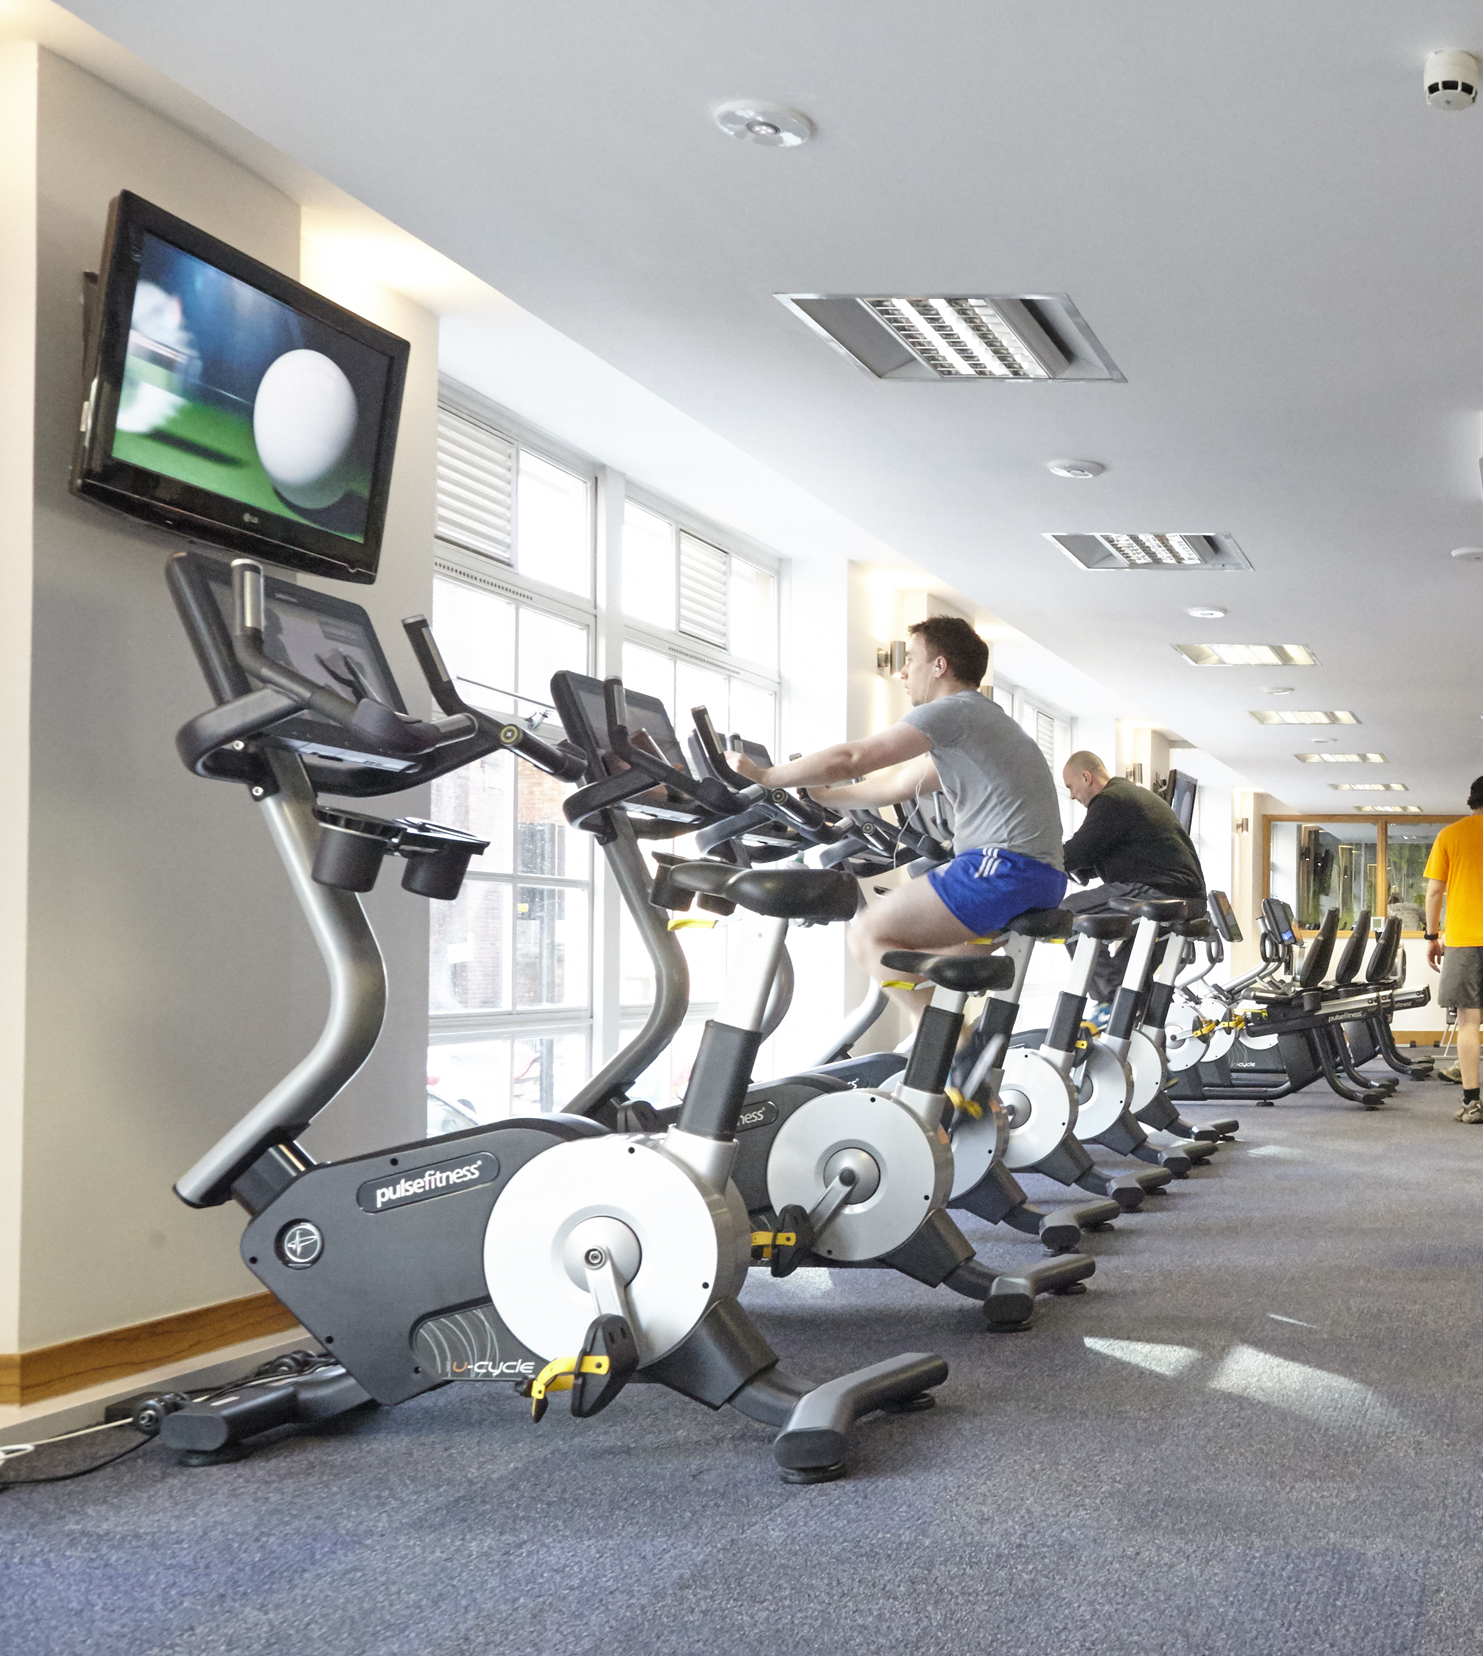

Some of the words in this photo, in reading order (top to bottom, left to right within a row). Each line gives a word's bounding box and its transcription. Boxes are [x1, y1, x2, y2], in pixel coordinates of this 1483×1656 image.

[737, 1108, 765, 1126] ness
[376, 1160, 482, 1208] pulsefitness
[452, 1358, 536, 1376] u-cycle
